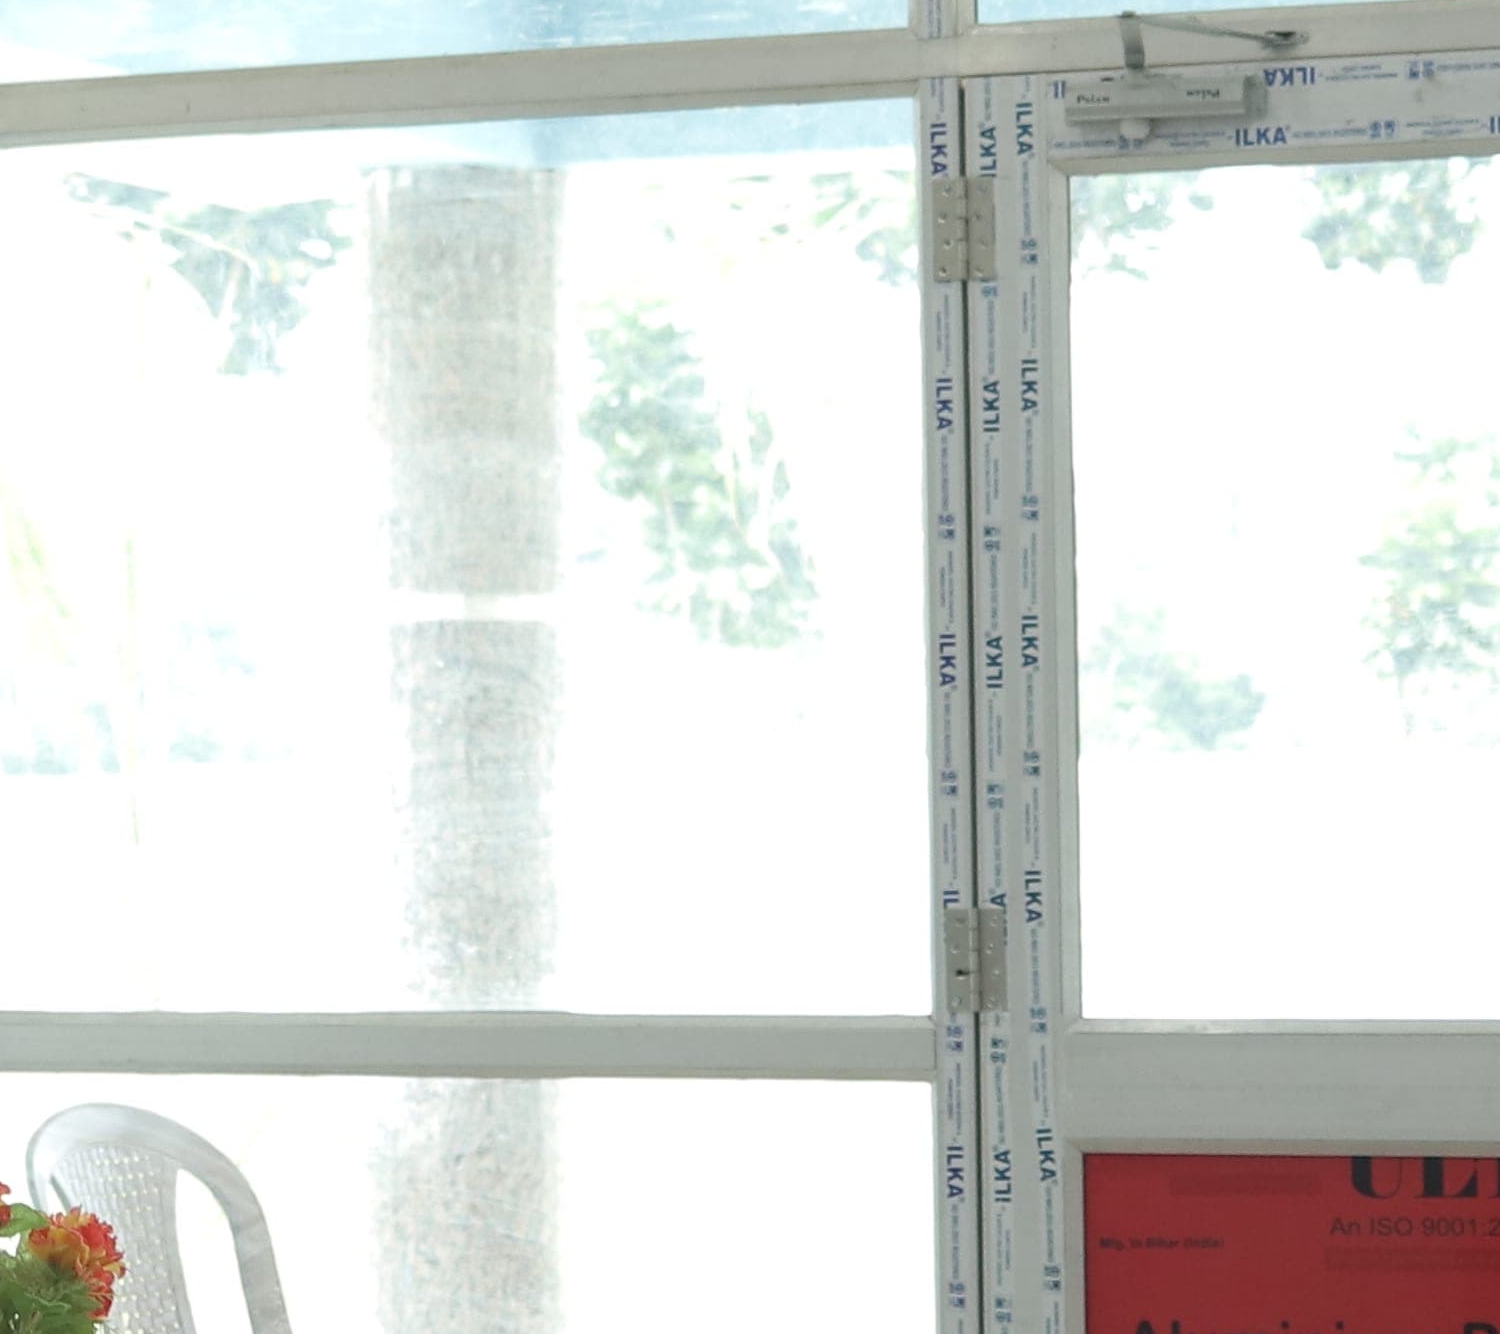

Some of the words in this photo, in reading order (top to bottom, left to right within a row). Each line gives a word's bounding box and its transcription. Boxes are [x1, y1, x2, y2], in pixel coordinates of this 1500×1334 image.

[1264, 67, 1315, 87] ILKA
[931, 123, 947, 175] ILKA
[980, 127, 996, 178] ILKA
[1016, 103, 1033, 155] ILKA
[1235, 127, 1286, 146] ILKA
[936, 378, 953, 430] ILKA
[983, 381, 1000, 432] ILKA
[1021, 359, 1037, 411] ILKA
[940, 634, 956, 686] ILKA
[986, 636, 1002, 688] ILKA
[1022, 615, 1038, 667] ILKA
[1025, 871, 1042, 922] ILKA
[947, 1146, 963, 1197] ILKA
[994, 1150, 1011, 1202] ILKA
[1036, 1129, 1056, 1181] ILKA
[1330, 1218, 1361, 1238] An
[1370, 1218, 1413, 1238] ISO
